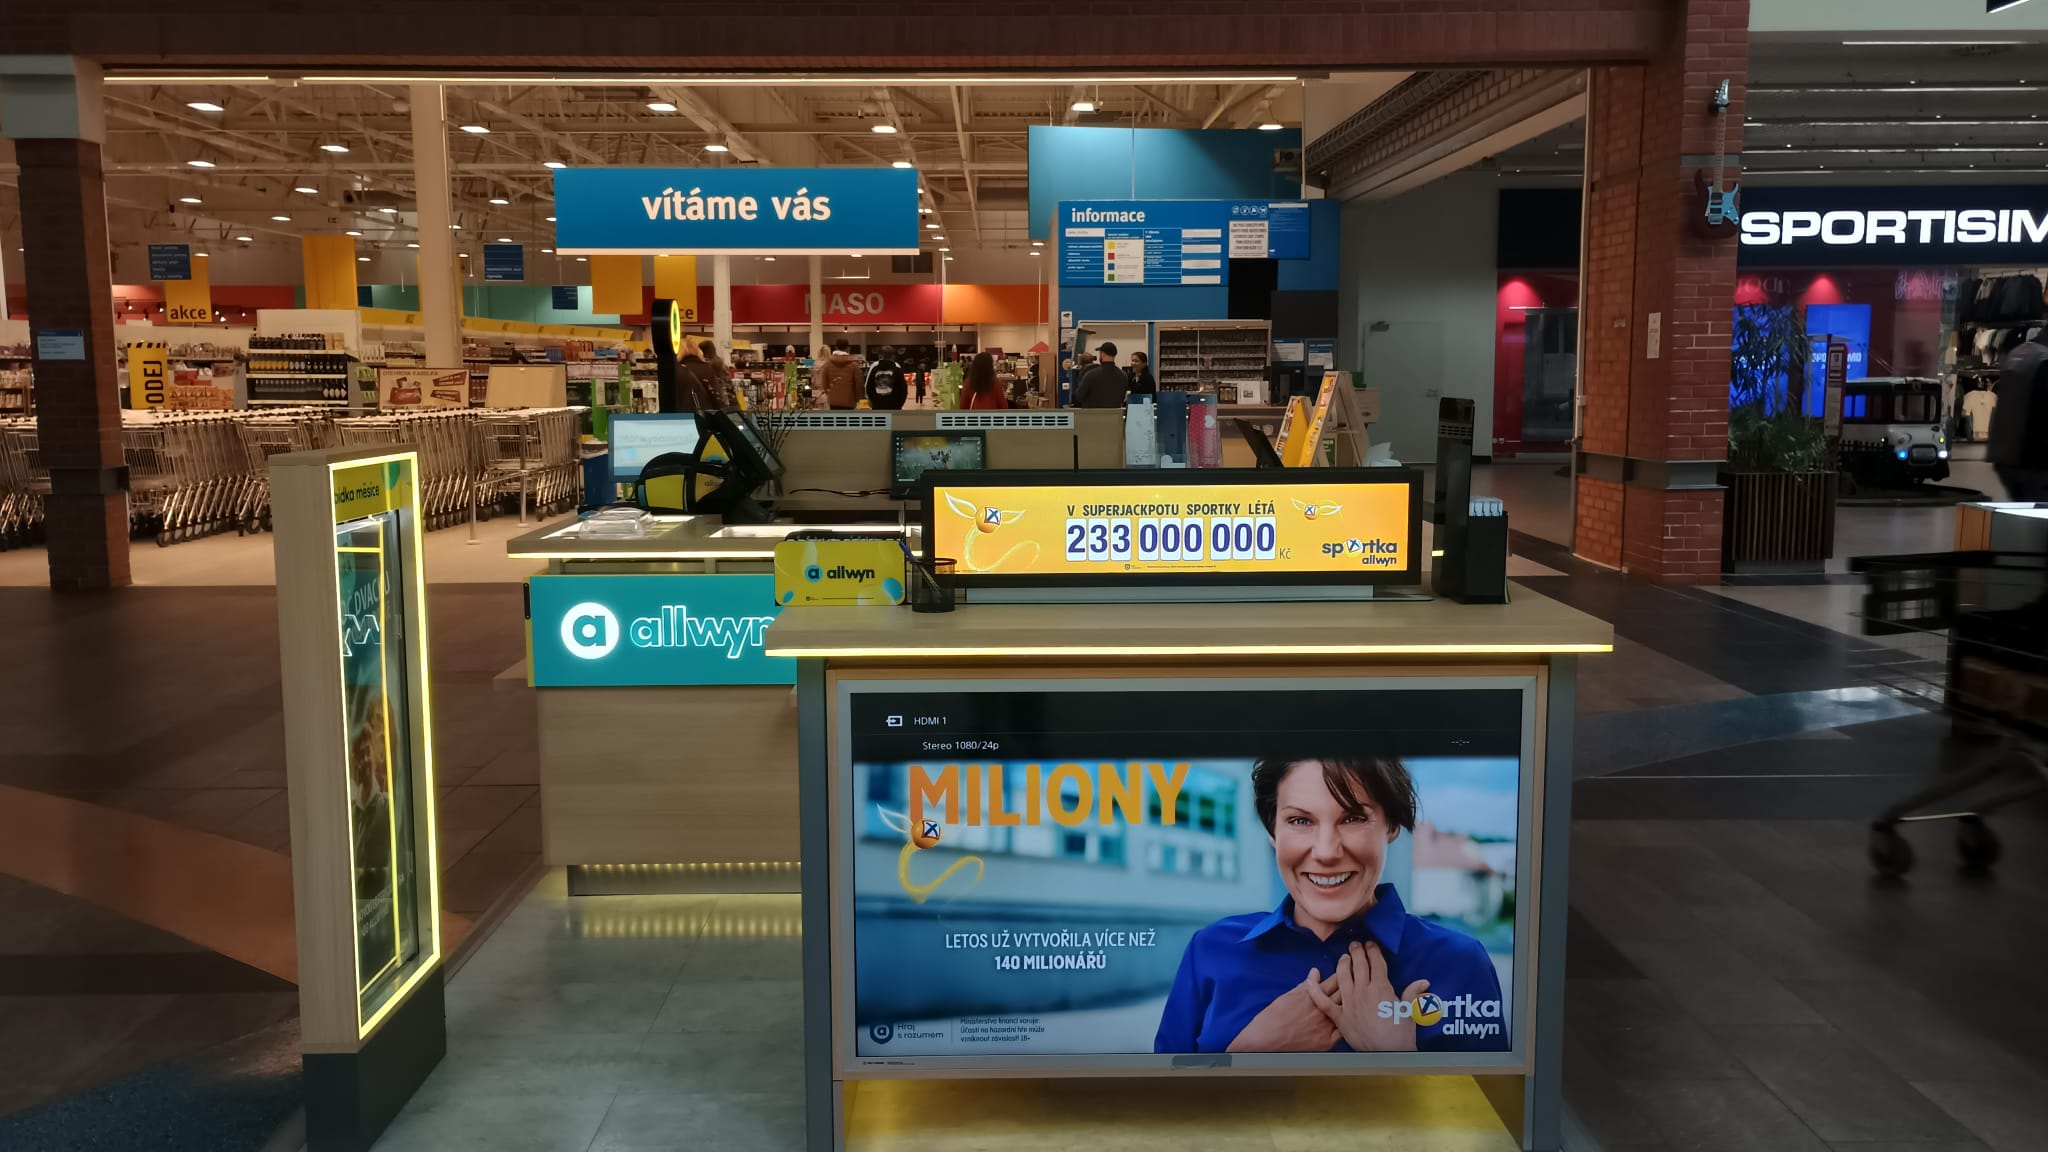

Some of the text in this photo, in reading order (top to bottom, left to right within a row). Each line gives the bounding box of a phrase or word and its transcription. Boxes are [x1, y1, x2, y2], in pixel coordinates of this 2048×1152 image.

[641, 187, 831, 221] vítáme vás
[1071, 207, 1146, 223] informace
[1740, 209, 2048, 245] SPORTISIM
[170, 305, 207, 320] akce
[143, 360, 165, 404] ODEJ
[1067, 500, 1276, 516] V SUPERJACKPOTU SPORTKY LÉTÁ
[1067, 523, 1291, 560] 233 000 000 Kč
[1362, 554, 1397, 567] allwyn
[826, 565, 875, 583] allwyn
[914, 717, 939, 725] HDMI
[922, 740, 999, 751] Stereo 1080/24p
[908, 763, 1191, 827] MILIONY
[945, 928, 1156, 949] LETOS UŽ VYTVOŘILA VÍCE NEŽ
[994, 949, 1107, 970] 140 MILIONÁŘŮ
[897, 1023, 915, 1031] Hraj
[1442, 1019, 1500, 1039] allwyn
